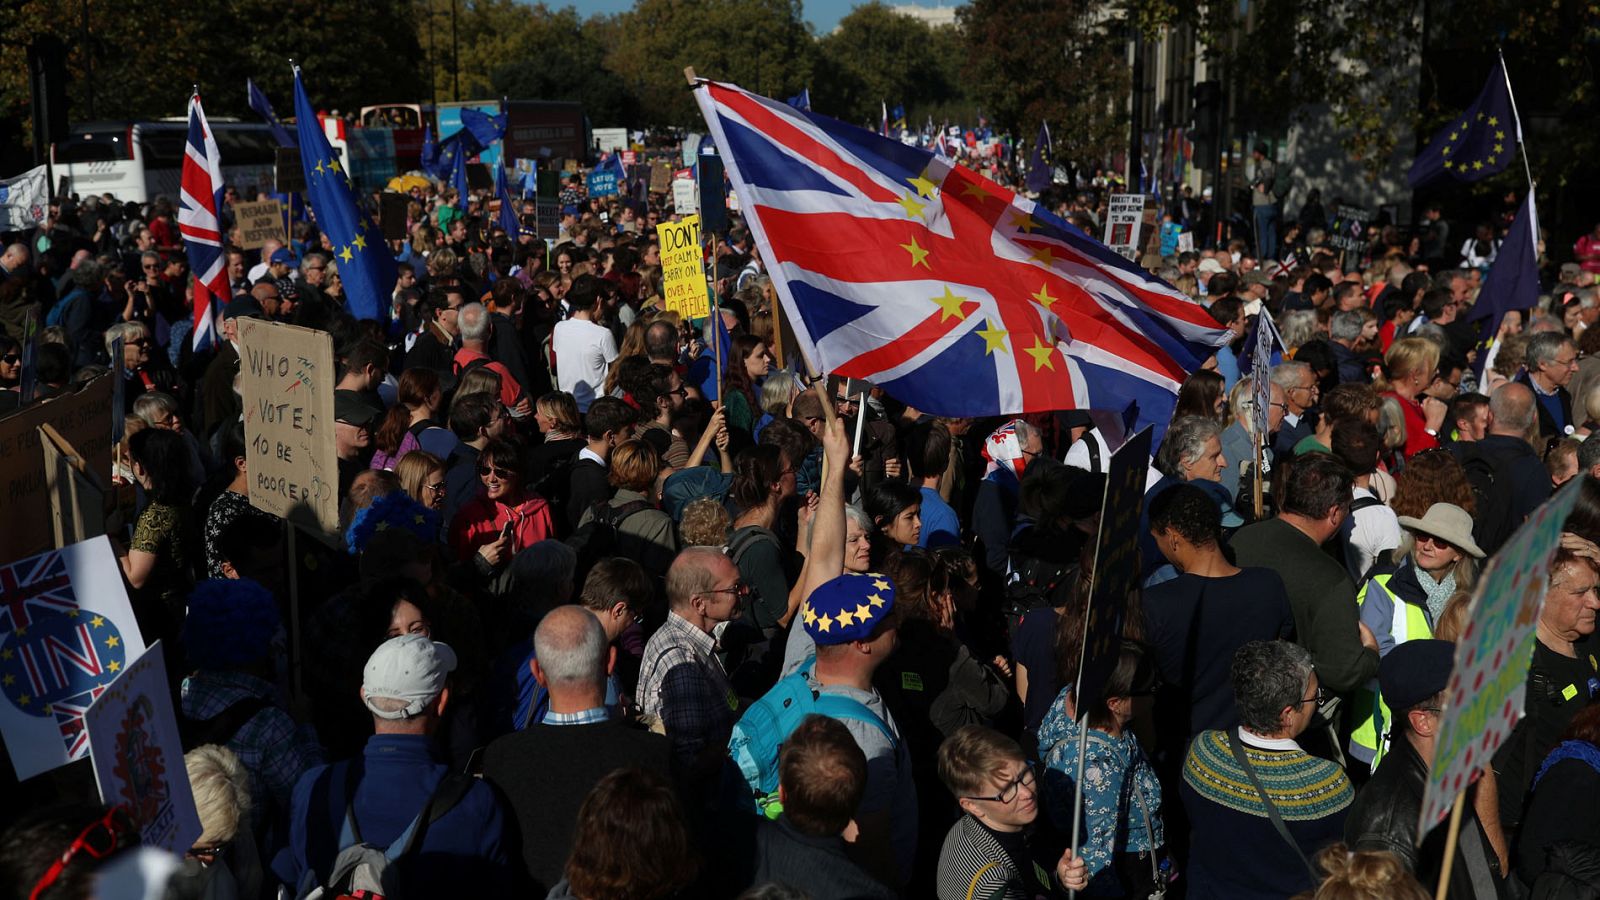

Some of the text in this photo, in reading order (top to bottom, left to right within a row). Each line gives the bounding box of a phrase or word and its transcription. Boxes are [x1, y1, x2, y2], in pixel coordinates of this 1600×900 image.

[593, 174, 614, 184] LET US
[594, 183, 613, 191] VOTE
[241, 204, 279, 219] REMAIN
[254, 217, 273, 227] AND
[245, 228, 285, 242] REFORM
[665, 222, 699, 252] DON'T
[674, 250, 692, 265] CALM
[664, 265, 697, 283] CARRY ON
[667, 283, 694, 298] OVER A
[246, 345, 290, 378] WHO
[259, 397, 317, 436] VOTES
[276, 441, 293, 464] BE
[18, 622, 105, 698] IN
